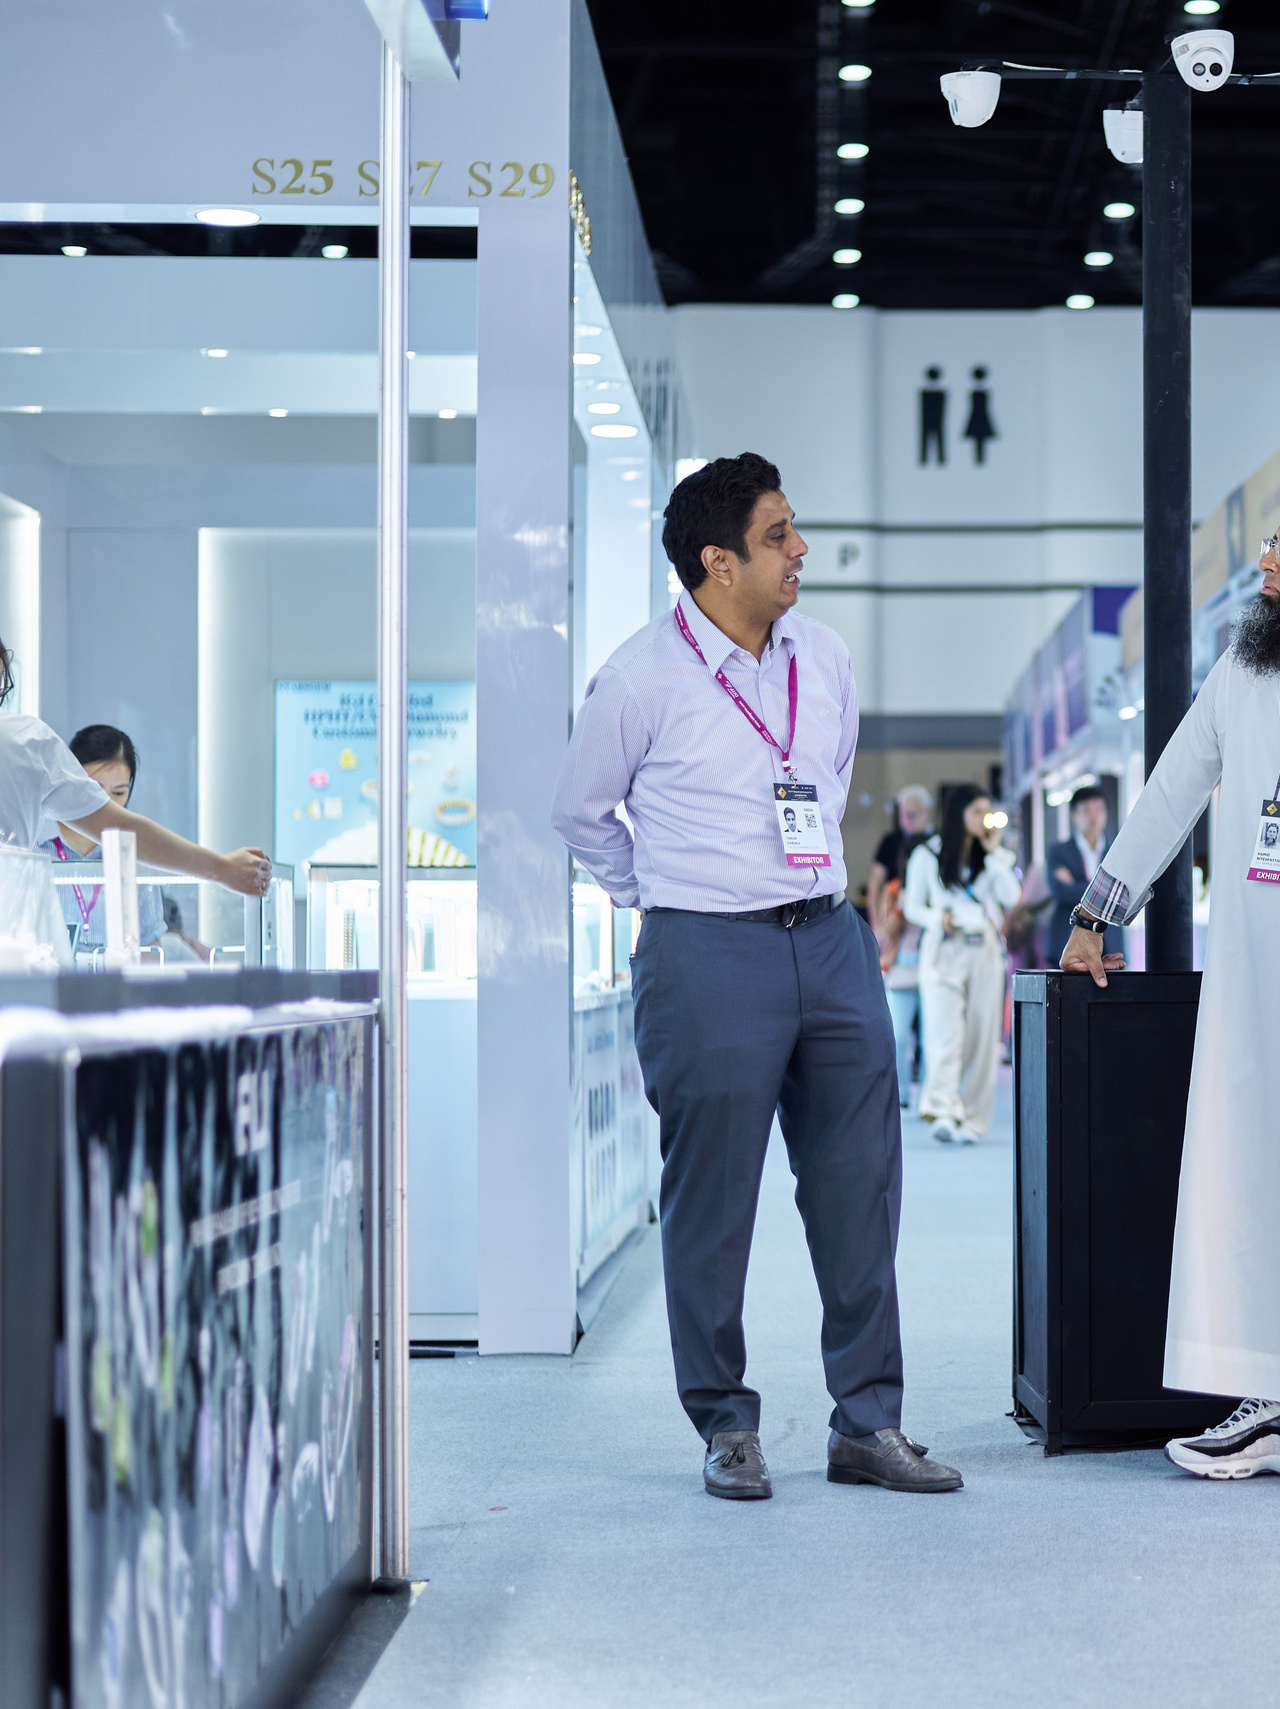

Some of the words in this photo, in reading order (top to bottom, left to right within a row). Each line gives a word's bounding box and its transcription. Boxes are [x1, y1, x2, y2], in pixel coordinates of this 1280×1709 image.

[251, 158, 334, 195] S25
[357, 160, 443, 197] S7
[467, 160, 555, 198] S29
[793, 856, 824, 864] EXHIBITOR
